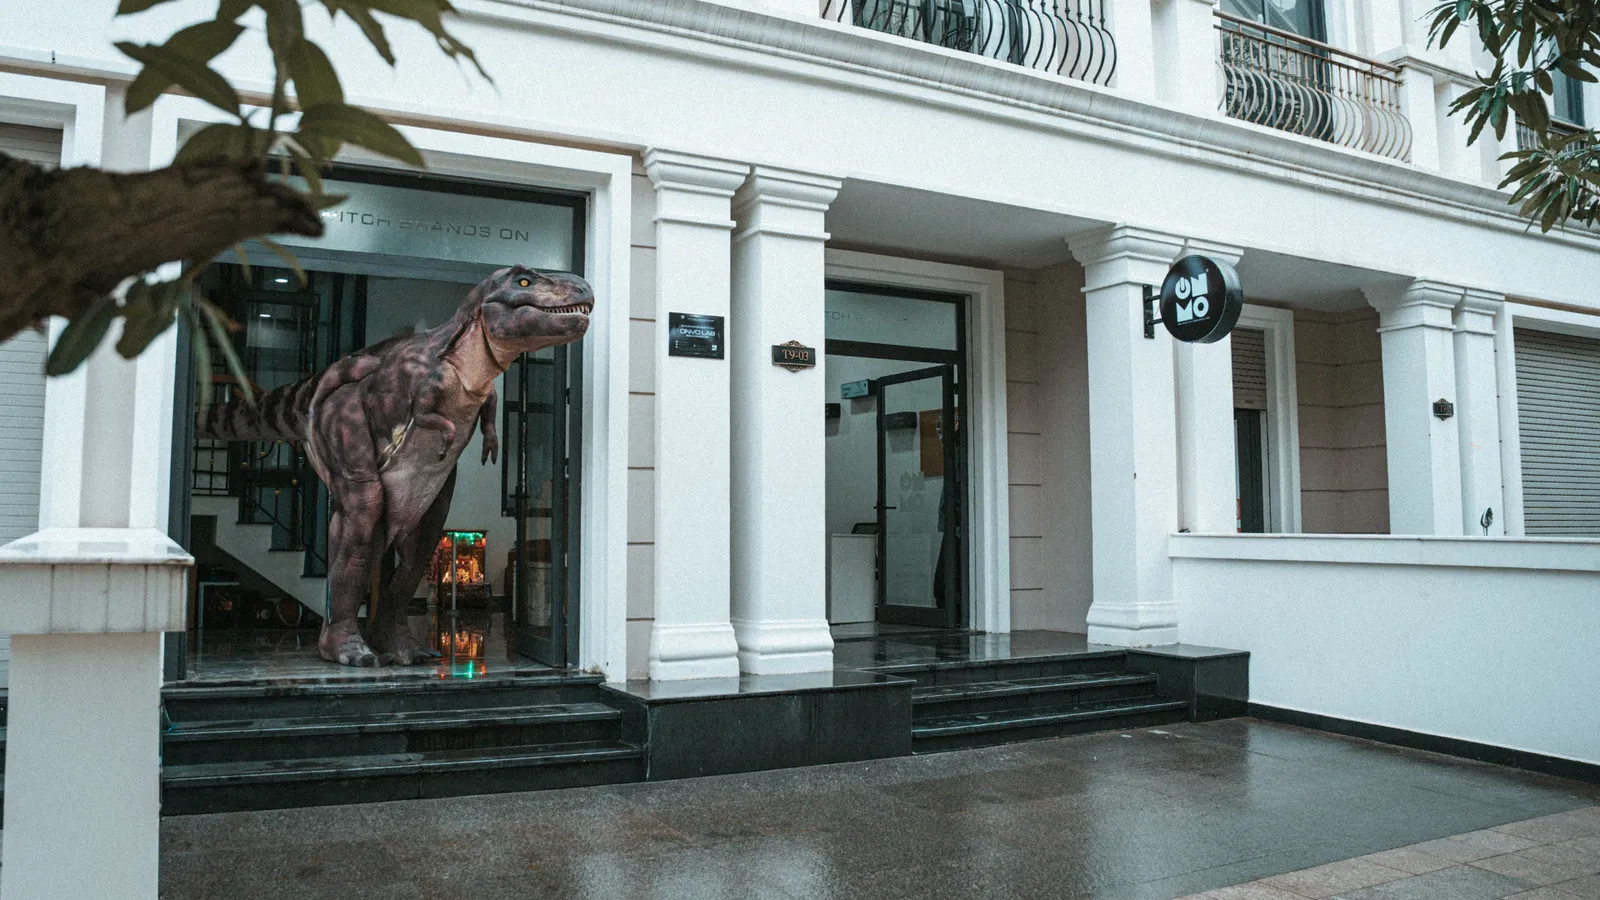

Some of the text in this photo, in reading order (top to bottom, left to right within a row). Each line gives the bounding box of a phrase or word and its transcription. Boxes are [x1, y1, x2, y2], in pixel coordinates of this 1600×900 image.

[330, 210, 391, 227] ITCH
[499, 228, 529, 241] ON
[1175, 296, 1209, 322] MO
[781, 349, 809, 360] T9-03
